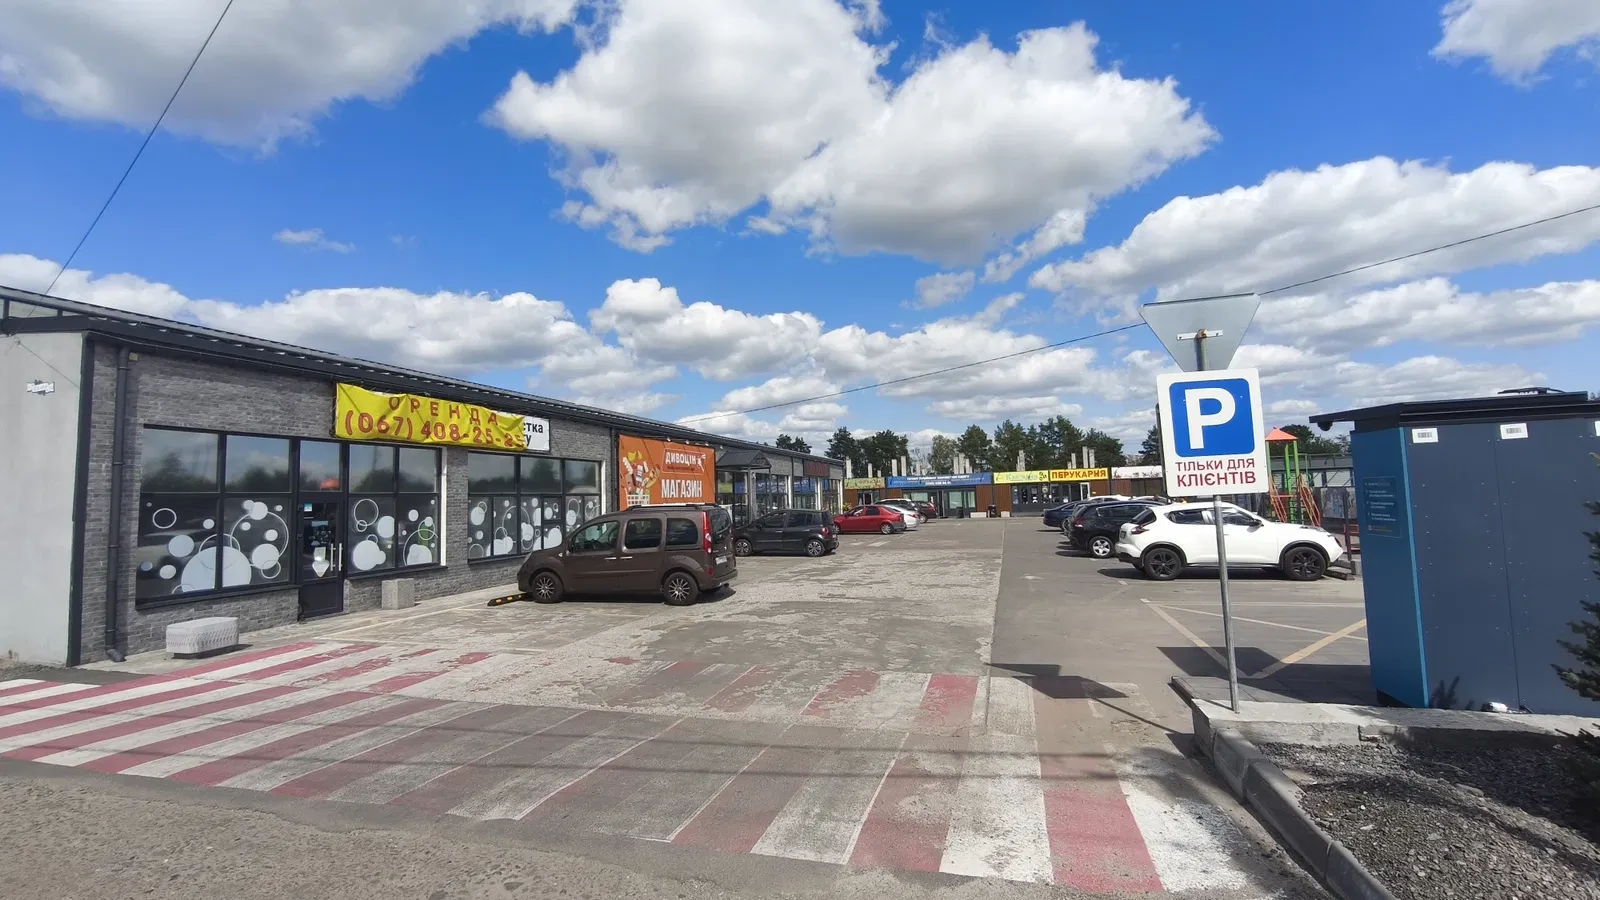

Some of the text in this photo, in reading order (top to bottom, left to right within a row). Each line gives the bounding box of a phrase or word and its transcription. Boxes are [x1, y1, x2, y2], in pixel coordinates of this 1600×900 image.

[389, 397, 498, 425] ОРЕНДА
[1185, 388, 1236, 450] P
[345, 410, 413, 440] (067)
[1051, 469, 1106, 479] ПЕРУКАРНЯ
[1175, 458, 1255, 472] ТІЛЬКИ ДЛЯ
[661, 479, 703, 498] МАГАЗИН
[1177, 471, 1257, 487] КЛІЄНТІВ
